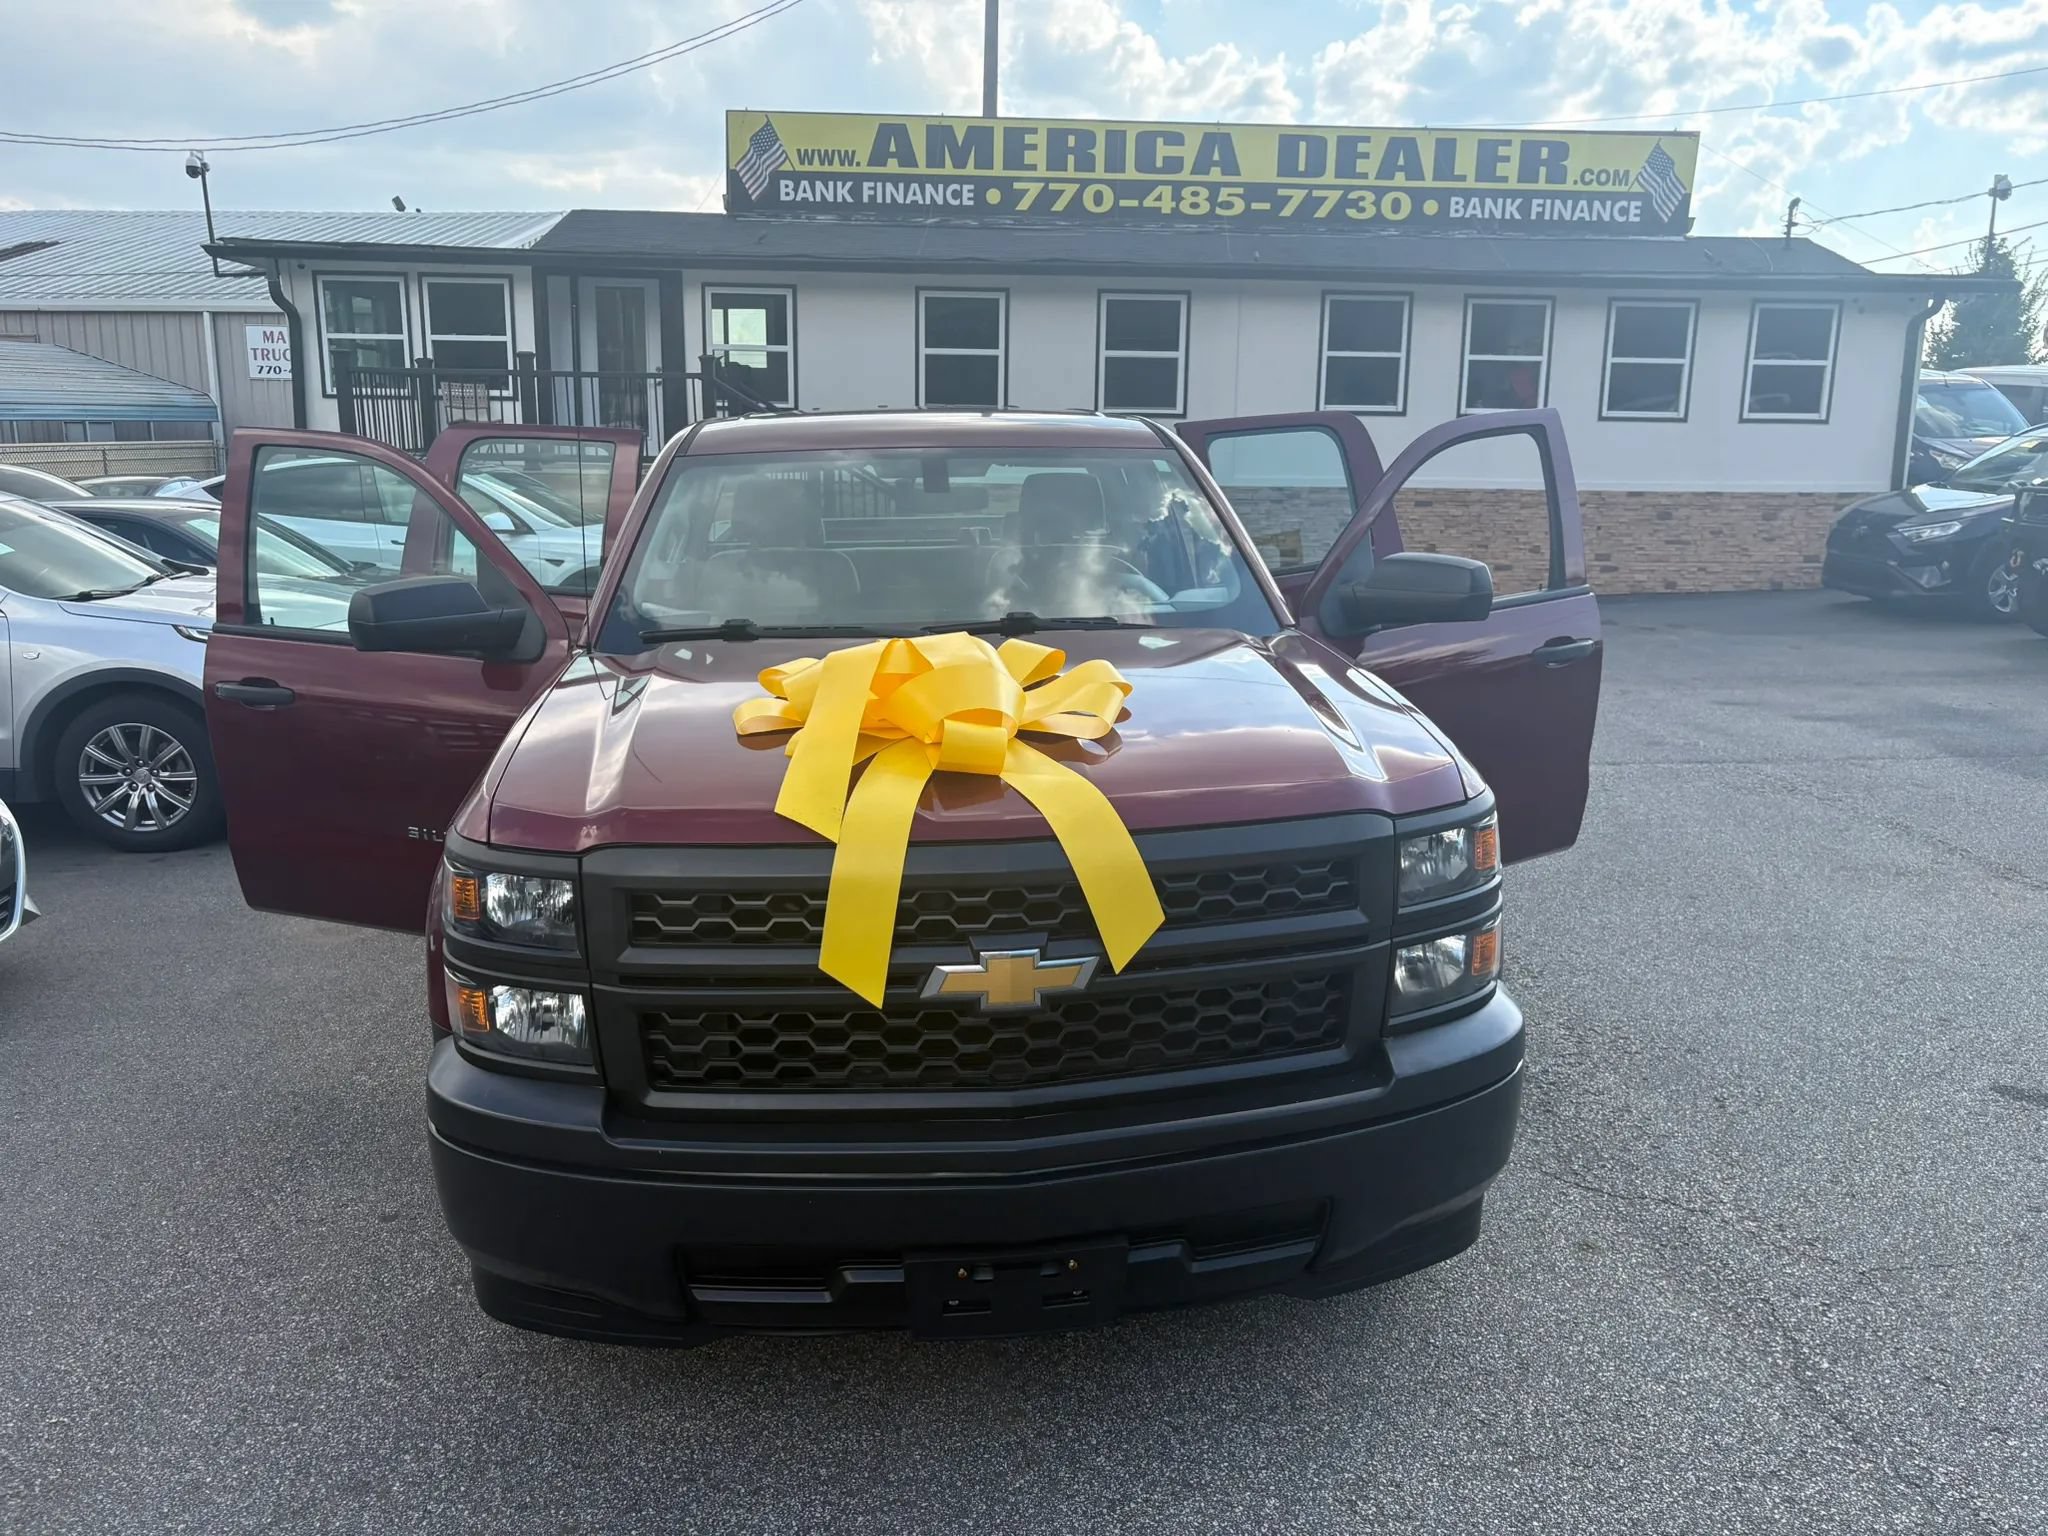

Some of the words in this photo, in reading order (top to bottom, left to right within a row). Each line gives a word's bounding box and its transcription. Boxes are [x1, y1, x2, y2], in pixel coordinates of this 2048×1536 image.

[779, 179, 854, 203] BANK
[862, 182, 975, 206] FINANCE
[1012, 182, 1412, 220] 770-485-7730
[1449, 196, 1524, 221] BANK
[1530, 198, 1642, 223] FINANCE
[256, 365, 291, 375] 770-
